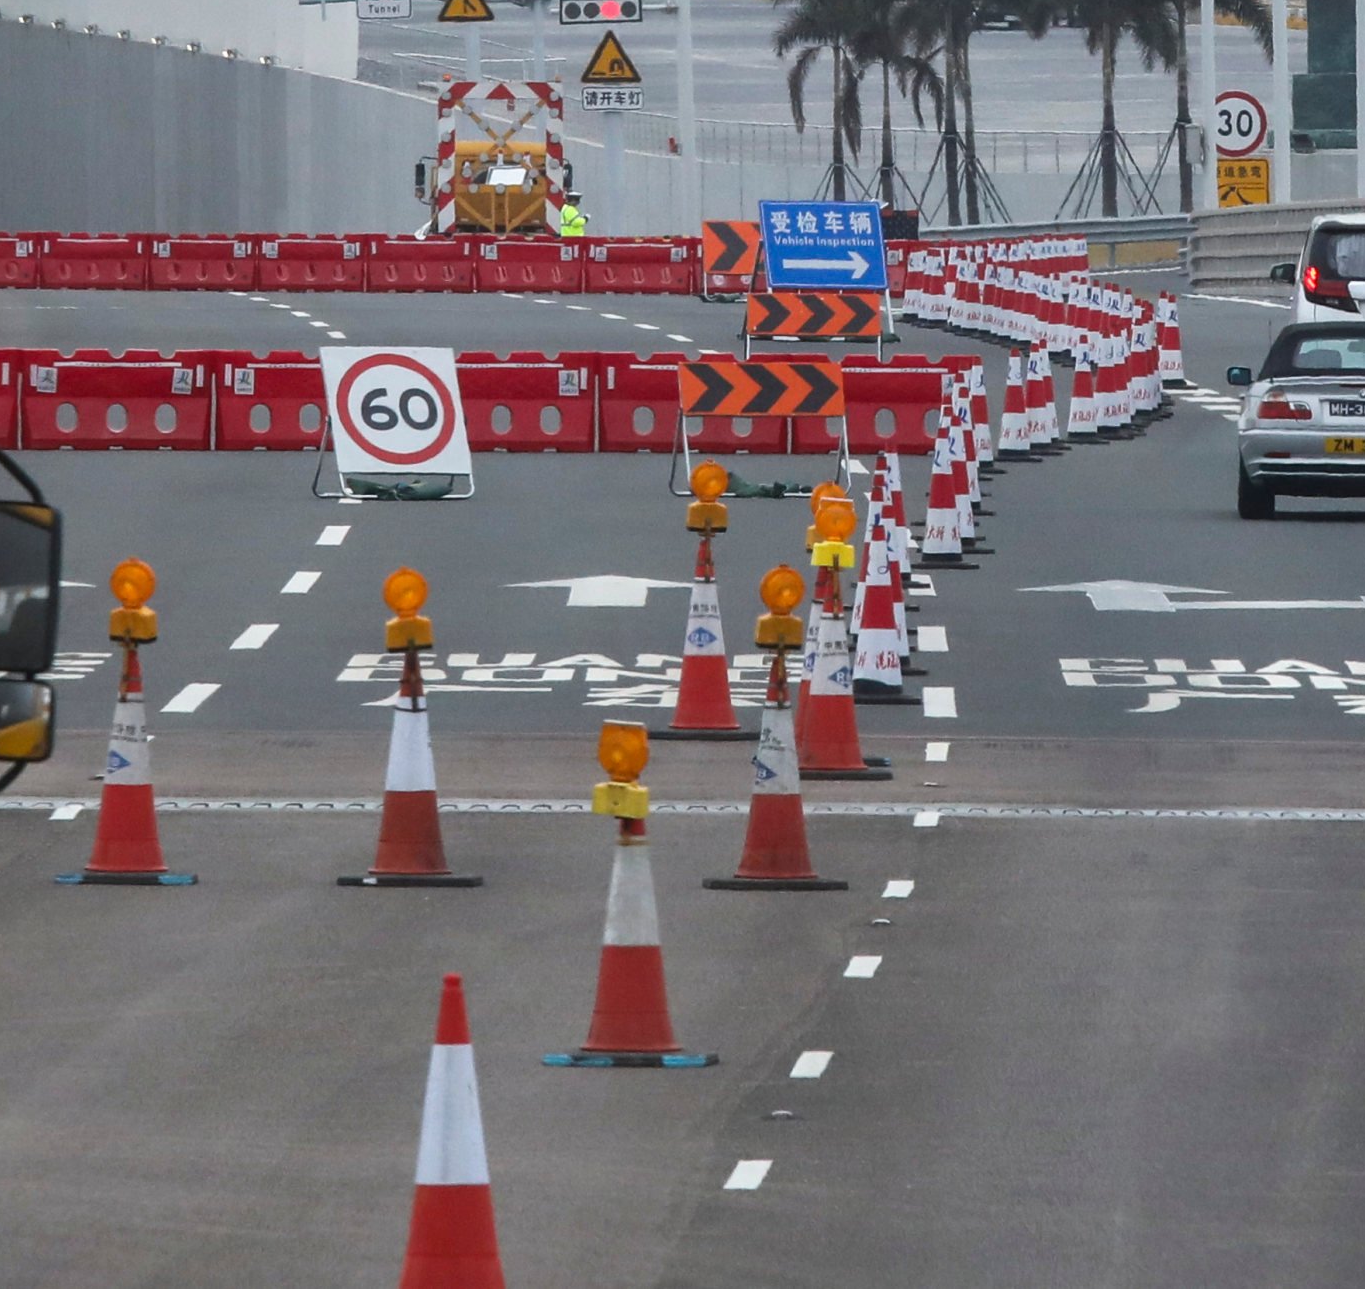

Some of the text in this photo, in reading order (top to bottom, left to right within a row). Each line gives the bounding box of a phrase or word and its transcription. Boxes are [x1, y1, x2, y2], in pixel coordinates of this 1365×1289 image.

[585, 90, 642, 106] 请开车灯
[1217, 109, 1253, 138] 30
[770, 210, 872, 235] 受检车辆
[774, 236, 814, 247] Vehicle
[360, 386, 438, 431] 60
[1333, 438, 1354, 452] ZM
